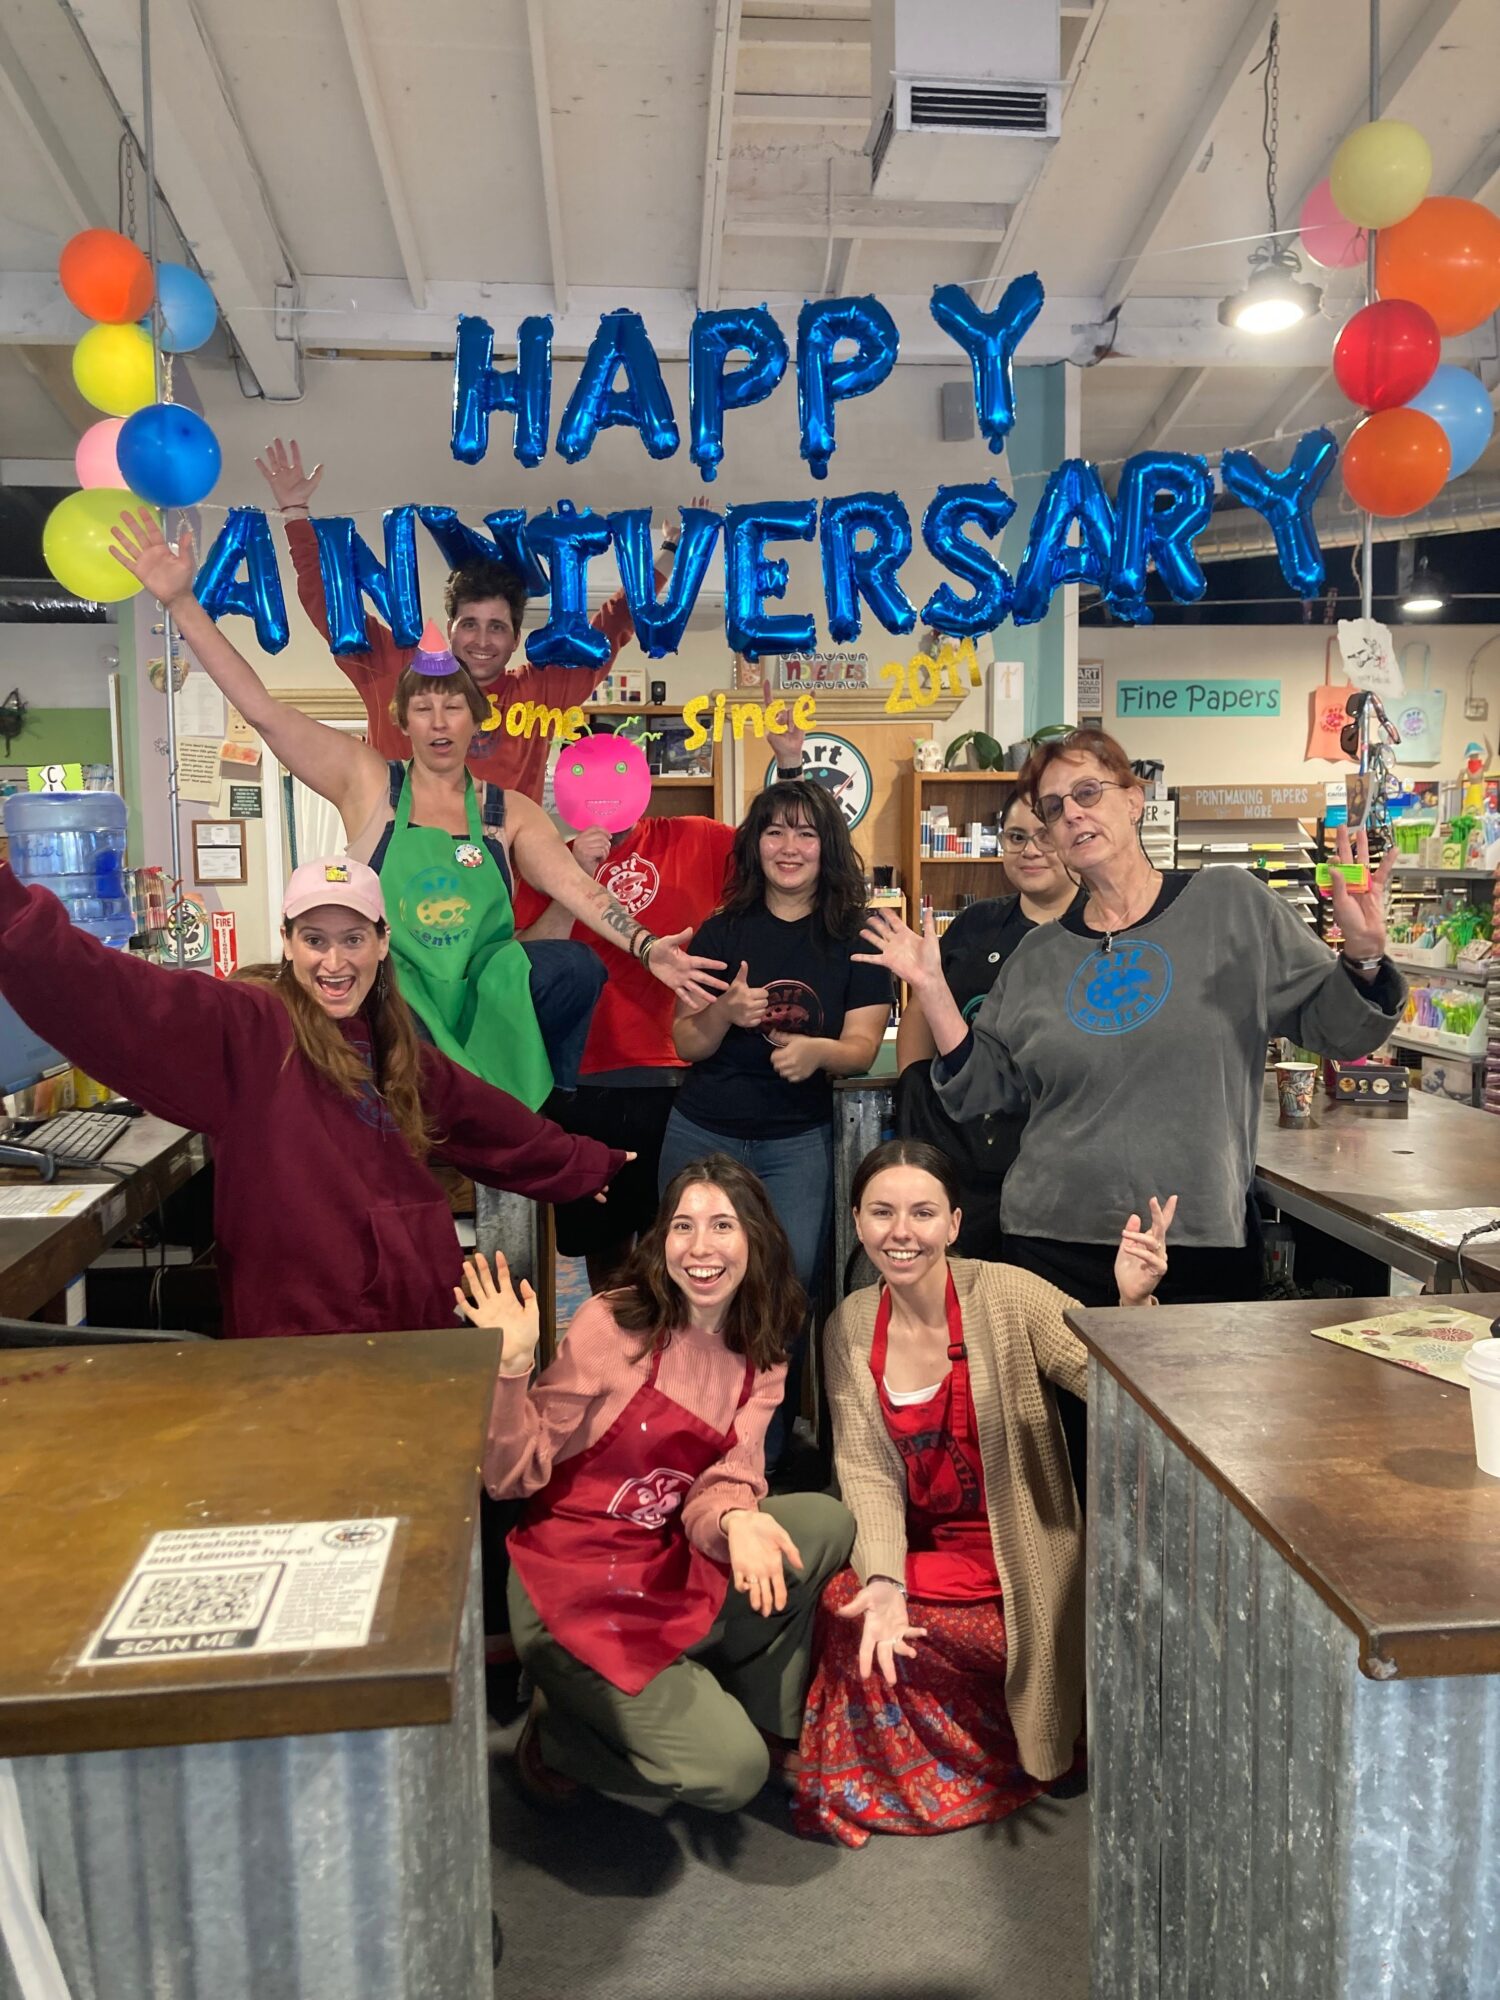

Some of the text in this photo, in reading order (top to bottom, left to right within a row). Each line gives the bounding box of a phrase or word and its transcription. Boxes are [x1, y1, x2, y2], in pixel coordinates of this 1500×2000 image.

[450, 272, 1045, 483] HAPPY
[880, 637, 983, 713] 2011
[1078, 668, 1098, 679] ART
[1120, 686, 1177, 712] Fine
[1185, 685, 1279, 712] Papers
[801, 746, 842, 765] art
[1196, 788, 1308, 807] PRINTMAKING PAPERS
[1244, 805, 1272, 819] MORE
[608, 857, 637, 875] art
[216, 918, 231, 927] FIRE
[1095, 949, 1143, 973] art
[637, 1478, 679, 1505] art
[160, 1527, 295, 1543] Check out our
[154, 1538, 262, 1553] workshops
[146, 1546, 313, 1565] and demos here!
[114, 1631, 238, 1656] SCAN ME
